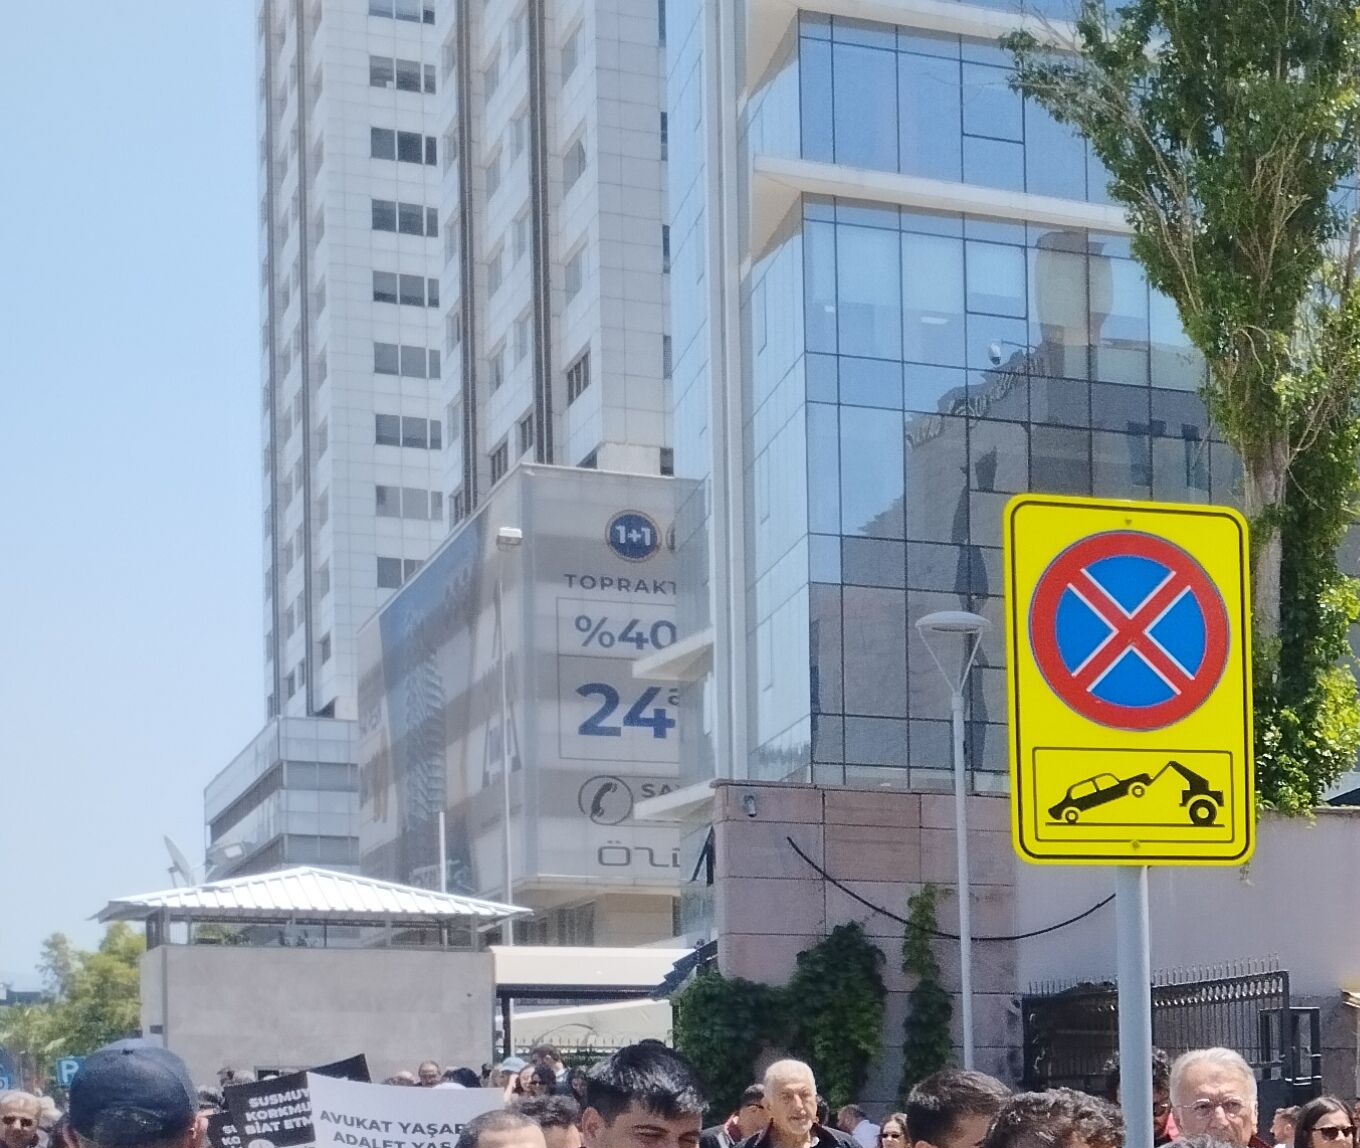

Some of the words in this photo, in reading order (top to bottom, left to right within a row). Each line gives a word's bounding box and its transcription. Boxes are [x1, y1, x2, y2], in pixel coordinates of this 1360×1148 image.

[615, 524, 651, 547] 1+1
[575, 682, 676, 739] 24
[61, 1060, 79, 1083] P
[245, 1120, 280, 1135] BİAT
[320, 1110, 393, 1133] AVUKAT
